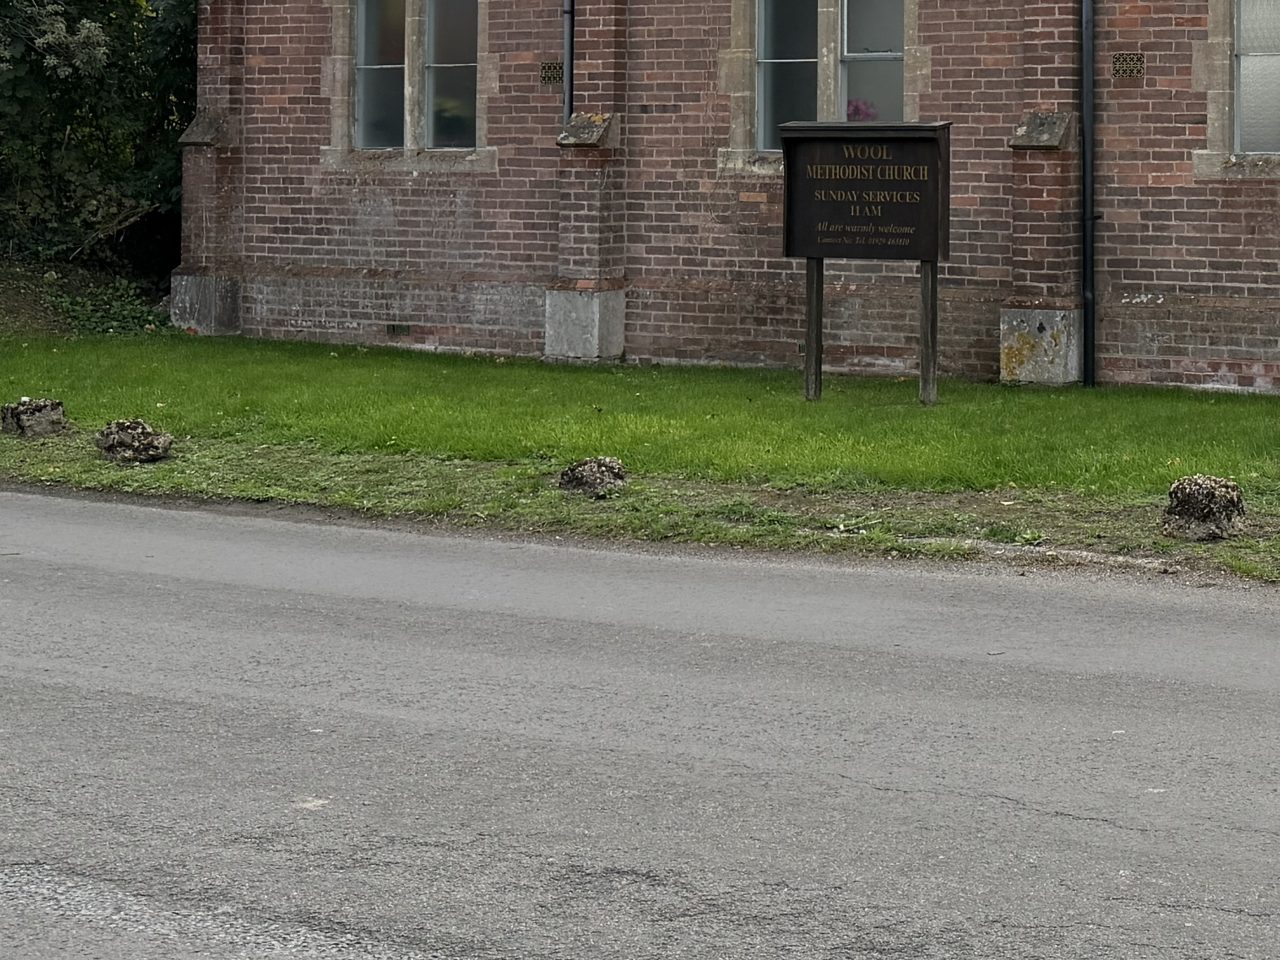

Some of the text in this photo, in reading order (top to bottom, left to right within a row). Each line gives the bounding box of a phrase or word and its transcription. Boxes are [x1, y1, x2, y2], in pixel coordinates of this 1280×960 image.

[843, 145, 892, 159] WOOL
[806, 165, 928, 180] METHODIST CHURCH
[815, 190, 920, 202] SUNDAY SERVICES
[851, 205, 881, 216] 11 AM
[817, 222, 916, 235] All are warmly welcome
